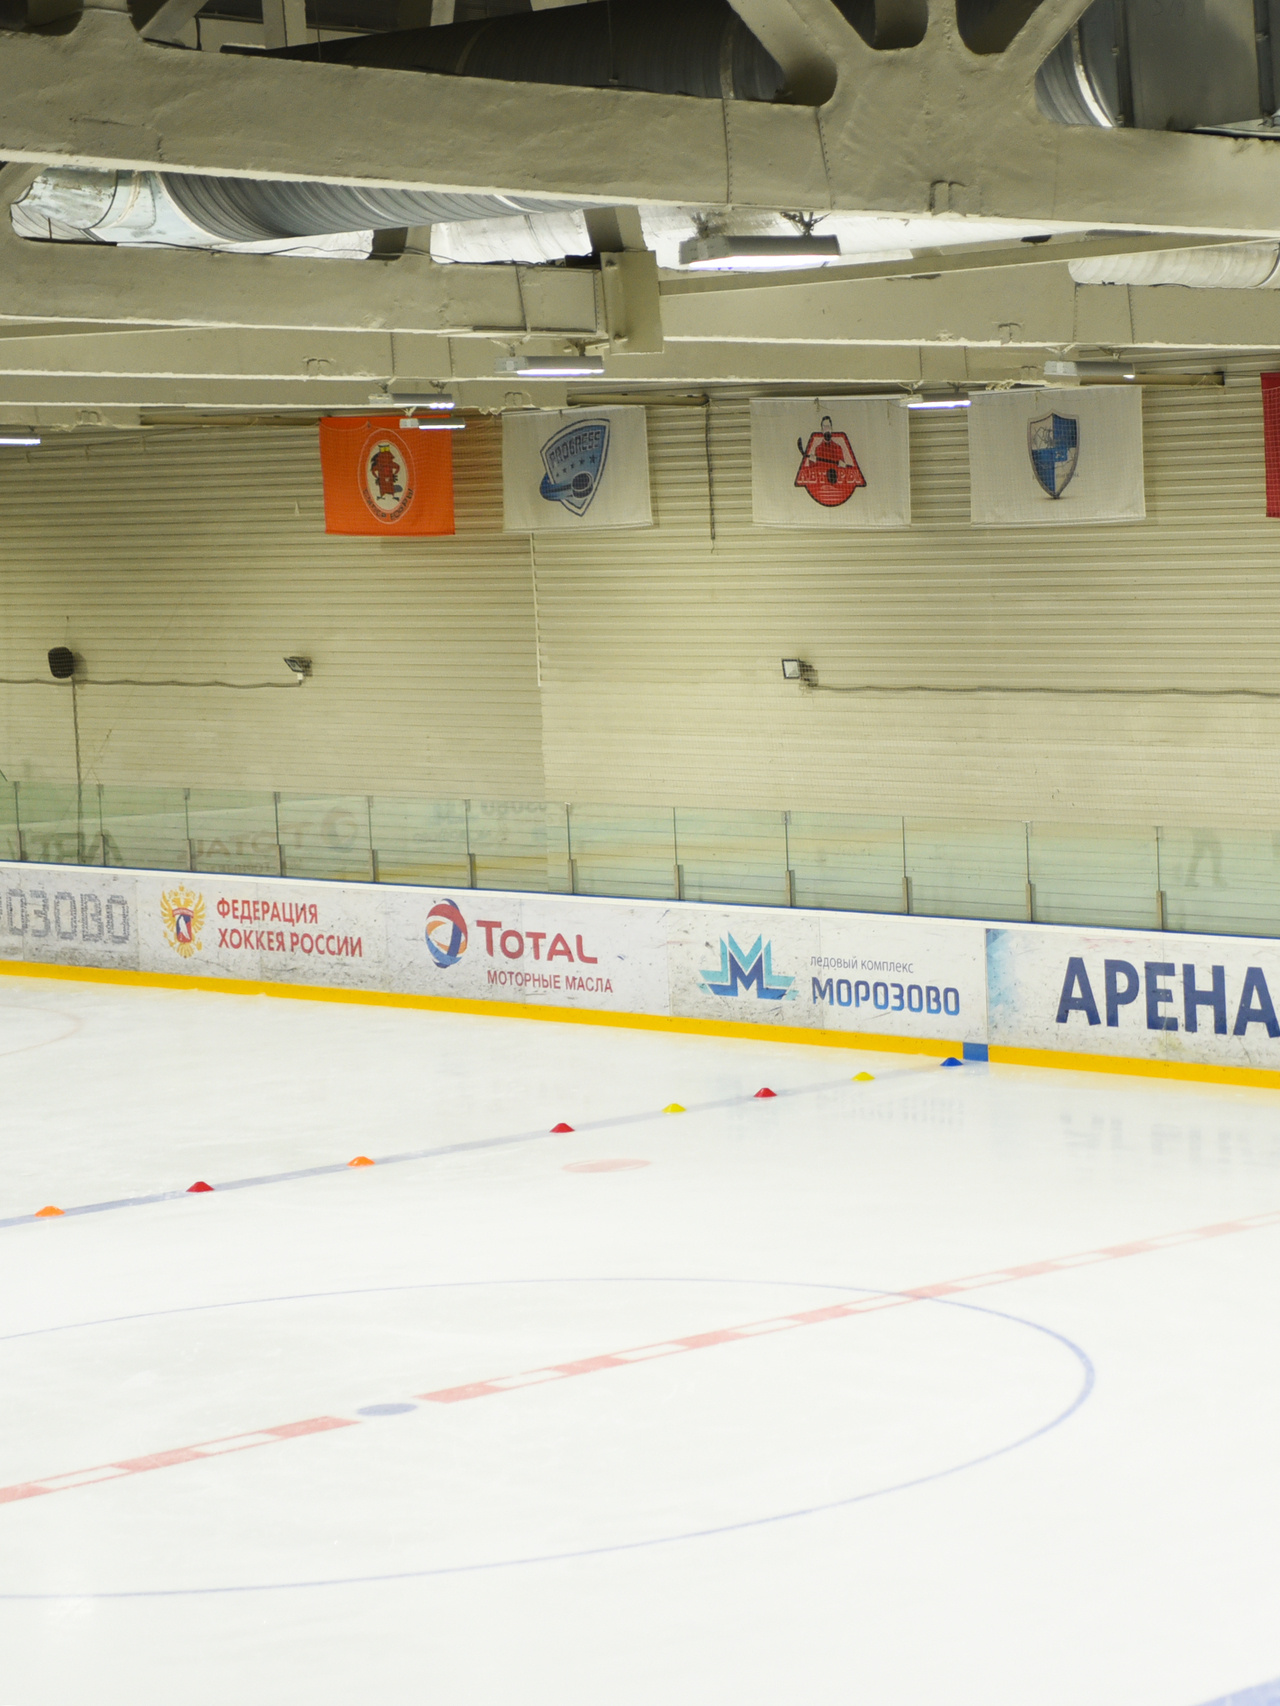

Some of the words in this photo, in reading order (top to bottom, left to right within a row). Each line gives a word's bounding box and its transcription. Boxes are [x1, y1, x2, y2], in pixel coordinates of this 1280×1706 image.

[548, 430, 602, 468] PROGRESS
[0, 887, 131, 944] ОЗОВО
[216, 897, 318, 927] ФЕДЕРАЦИЯ
[218, 928, 286, 952] ХОККЕЯ
[290, 932, 363, 958] РОССИИ
[476, 909, 598, 965] TOTAL
[487, 970, 561, 990] МОТОРНЫЕ
[565, 975, 613, 994] МАСЛА
[810, 955, 858, 971] ледовый
[861, 960, 914, 975] комплекс
[811, 976, 960, 1017] МОРОЗОВО
